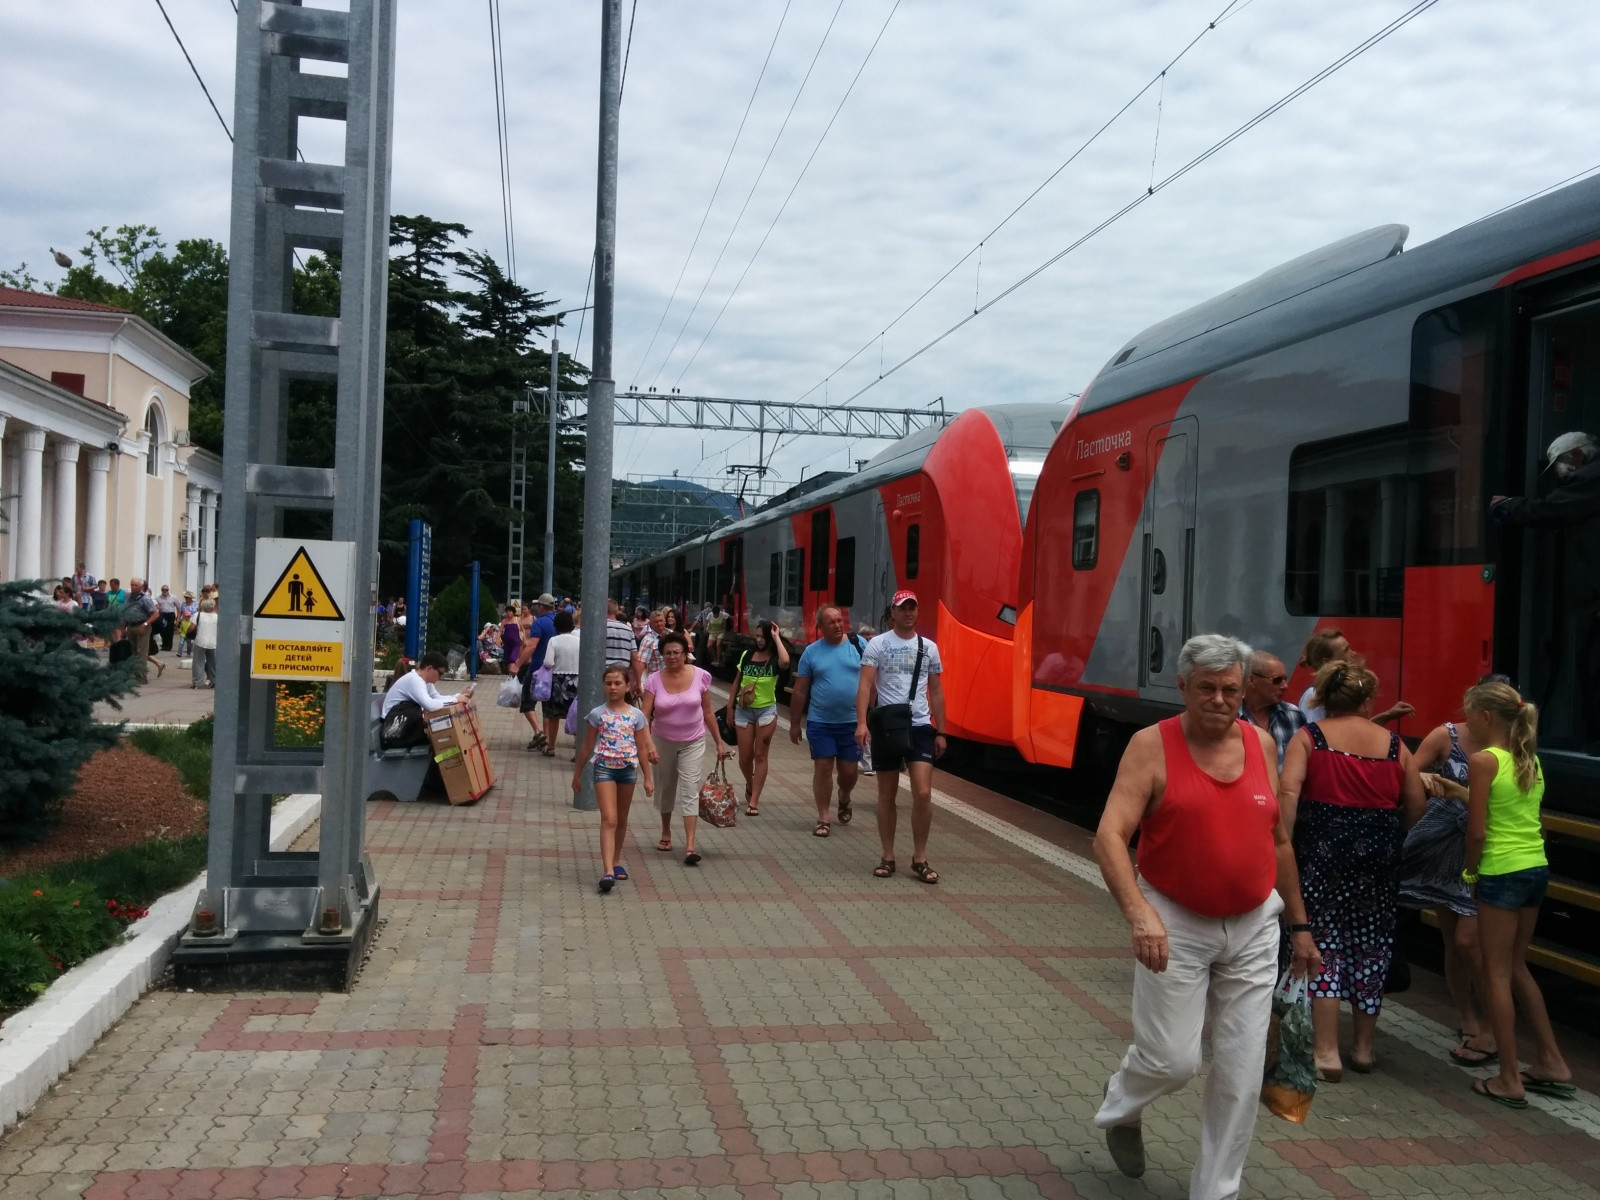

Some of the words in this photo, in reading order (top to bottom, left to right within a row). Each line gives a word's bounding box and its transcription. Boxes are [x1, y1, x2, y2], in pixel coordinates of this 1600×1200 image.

[1076, 430, 1132, 460] Ласточка
[265, 643, 277, 651] НЕ
[278, 644, 333, 653] ОСТАВЛЯЙТЕ
[285, 654, 312, 662] ДЕТЕЙ
[279, 664, 334, 673] ПРИСМОТРА!
